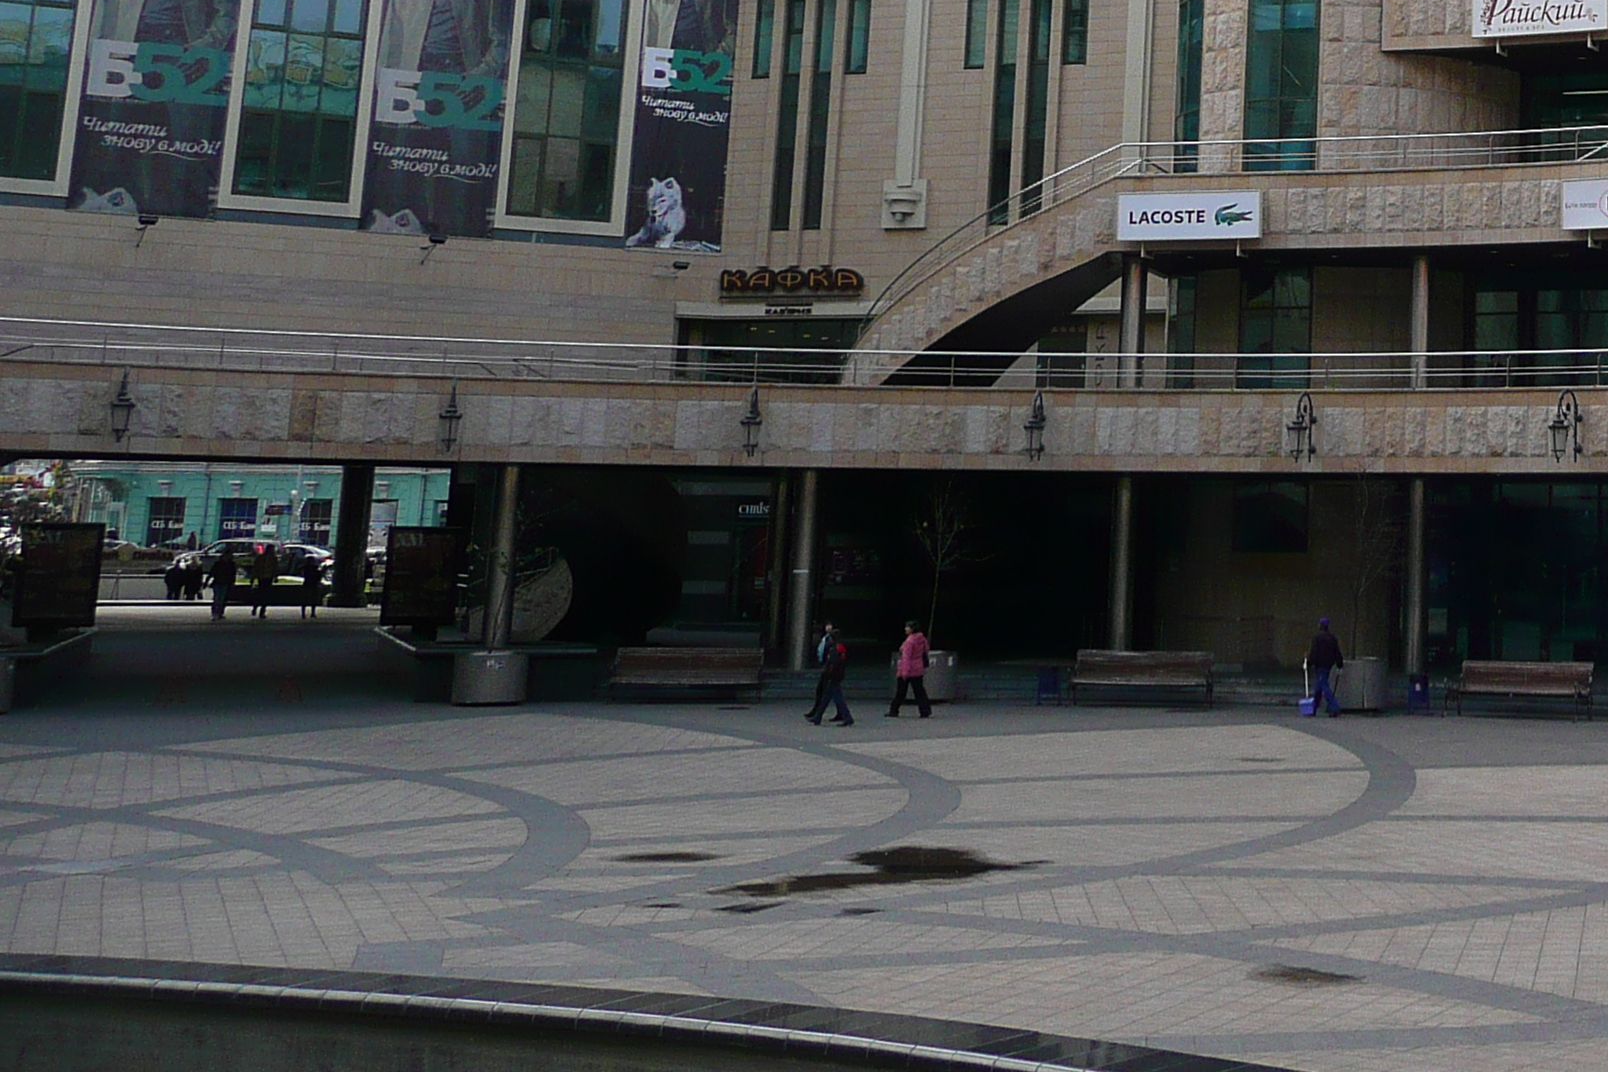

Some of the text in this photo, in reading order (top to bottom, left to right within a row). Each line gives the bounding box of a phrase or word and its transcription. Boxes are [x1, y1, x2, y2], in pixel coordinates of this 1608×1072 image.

[642, 94, 695, 110] Читати
[653, 108, 687, 121] знову
[696, 111, 729, 123] моді!
[83, 116, 167, 137] Читати
[101, 135, 155, 153] знову
[169, 139, 221, 155] моді!
[372, 141, 448, 161] Читати
[389, 159, 438, 177] знову
[450, 163, 498, 177] моді!
[1129, 209, 1206, 225] LACOSTE
[721, 269, 864, 291] КАФКА
